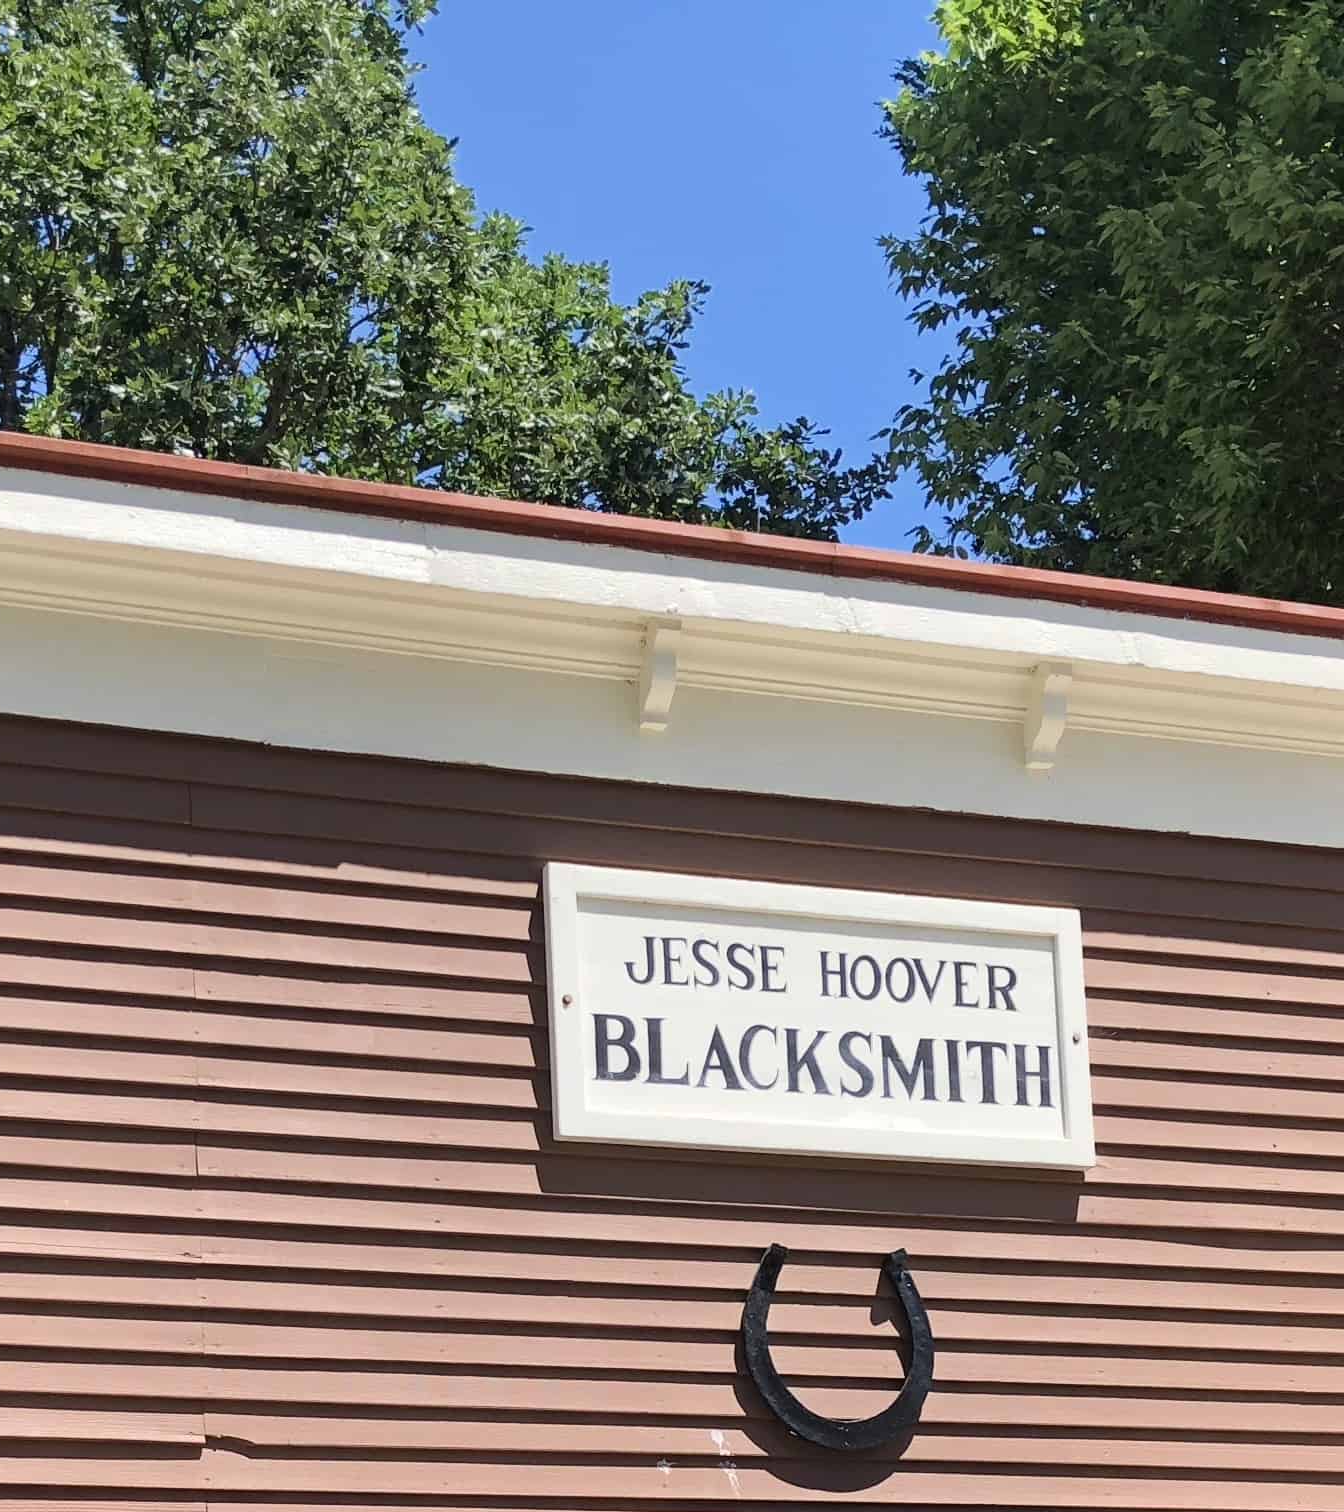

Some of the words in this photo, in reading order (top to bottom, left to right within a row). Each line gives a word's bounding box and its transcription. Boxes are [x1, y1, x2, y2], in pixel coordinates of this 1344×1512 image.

[625, 936, 787, 993] JESSE
[820, 951, 1018, 1011] HOOVER
[592, 1013, 1054, 1108] BLACKSMITH
